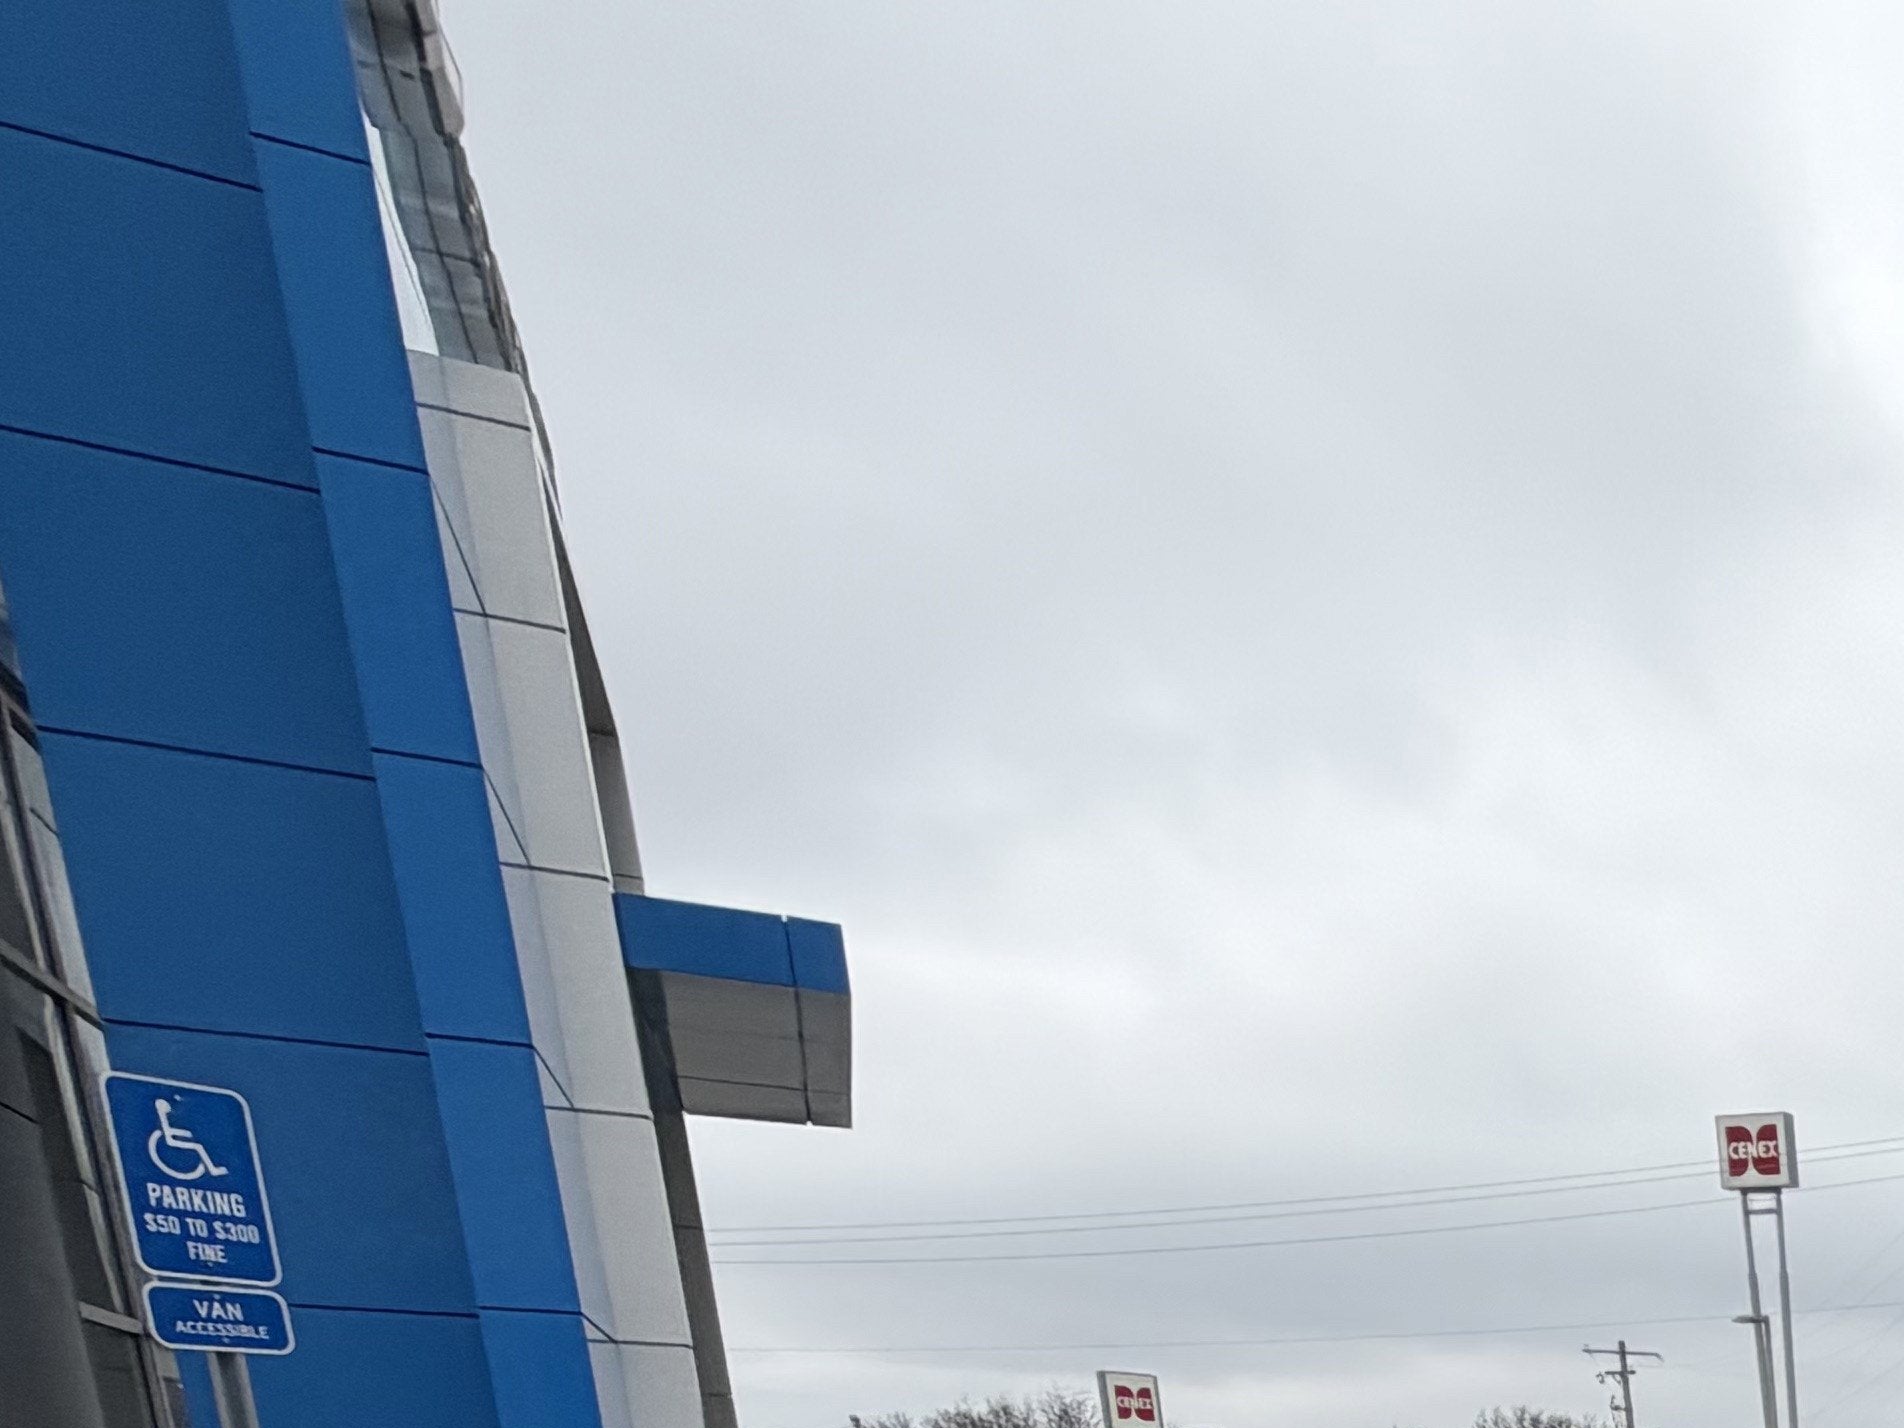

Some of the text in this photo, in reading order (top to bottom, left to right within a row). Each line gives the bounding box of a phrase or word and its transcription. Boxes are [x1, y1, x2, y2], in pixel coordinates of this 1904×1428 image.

[1729, 1140, 1778, 1159] CENEX
[147, 1182, 246, 1218] PARKING
[145, 1213, 260, 1244] $50 TO $300
[186, 1240, 227, 1263] FINE
[193, 1299, 243, 1321] VAN
[176, 1320, 269, 1340] ACCESSIBLE
